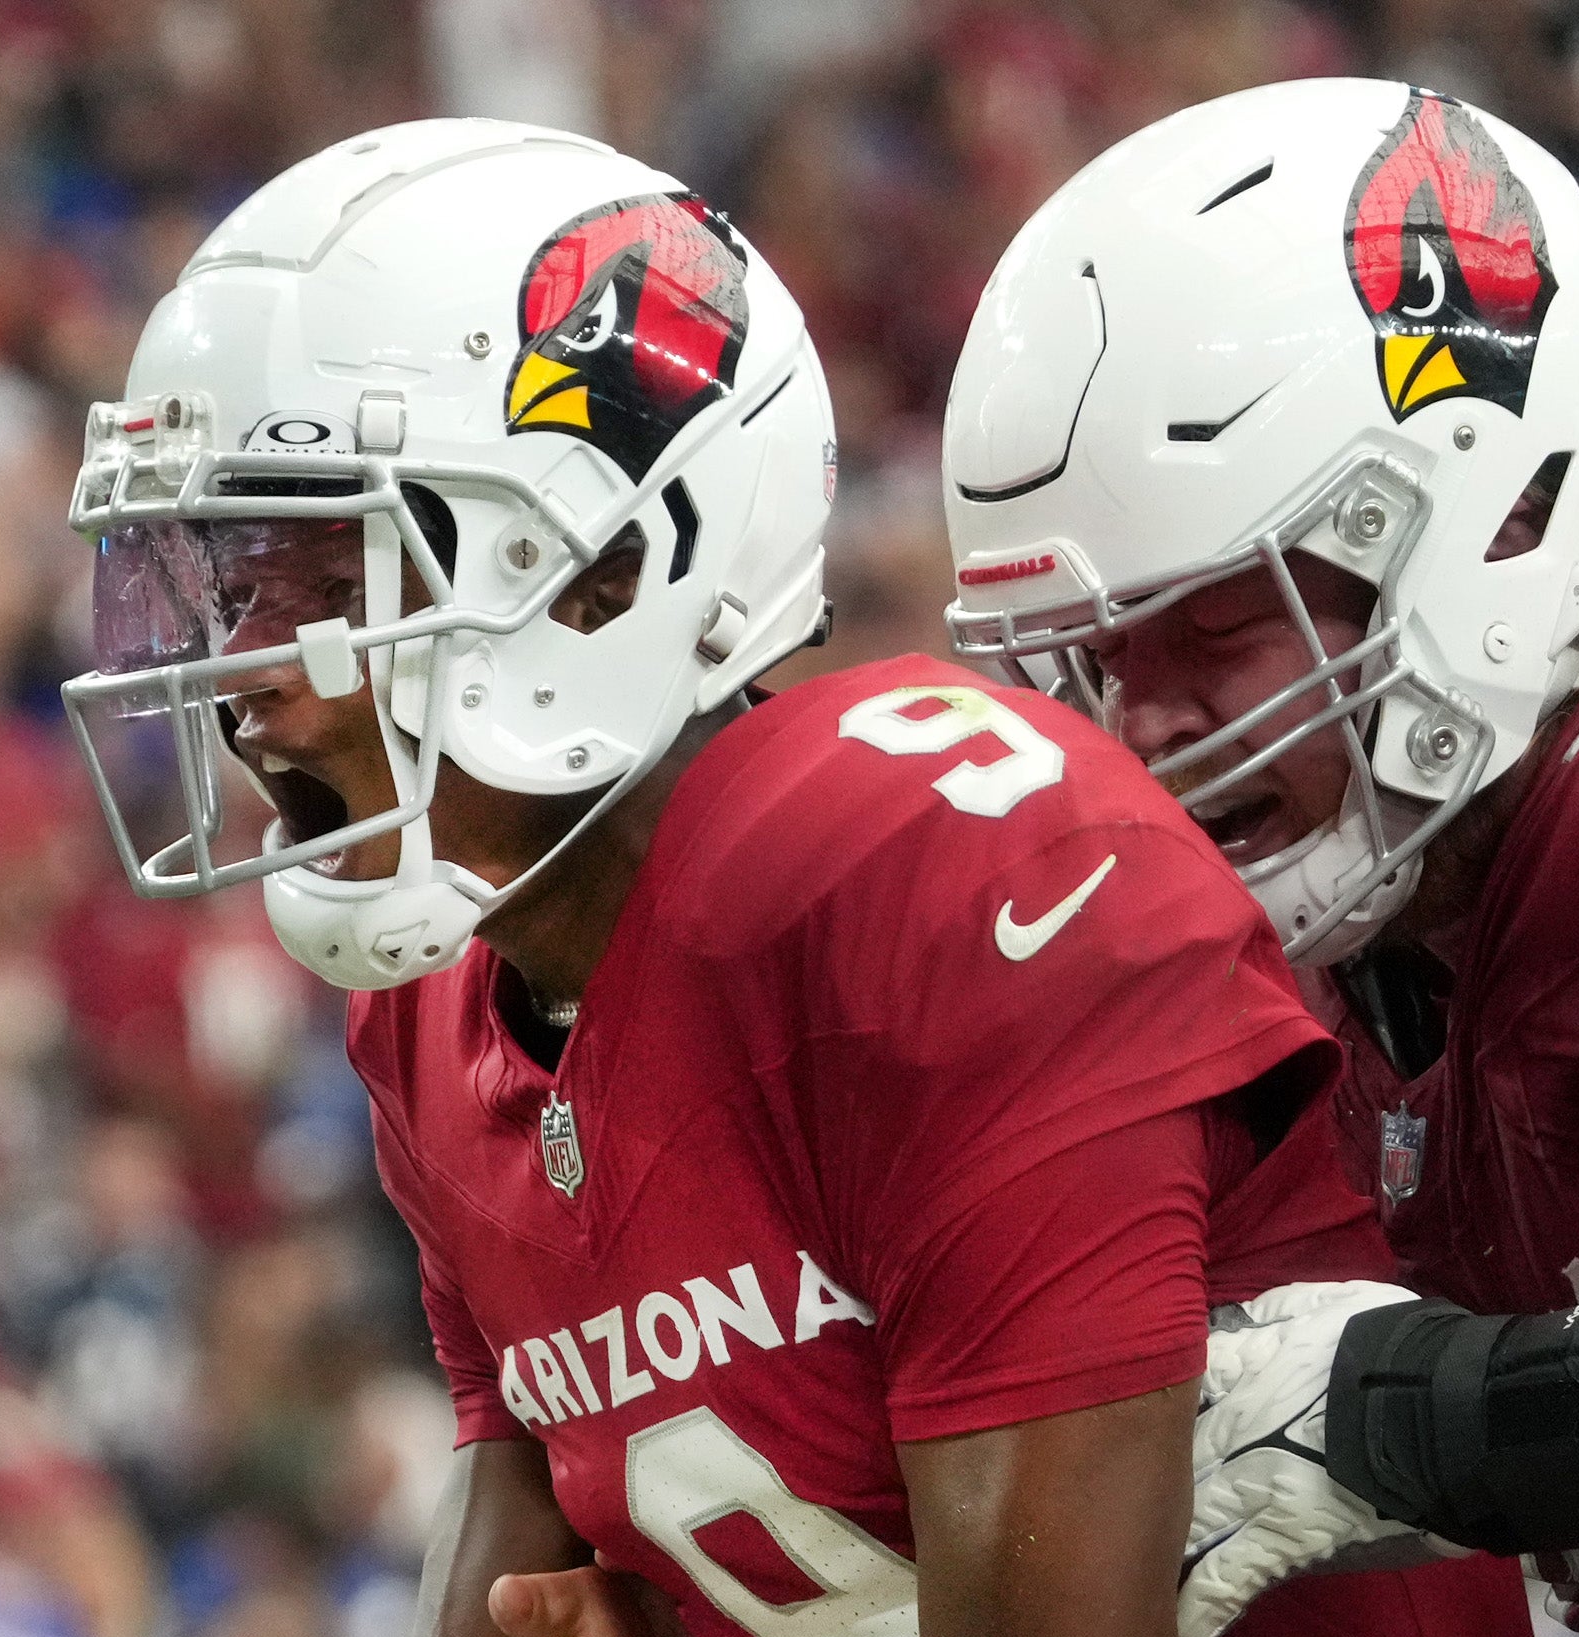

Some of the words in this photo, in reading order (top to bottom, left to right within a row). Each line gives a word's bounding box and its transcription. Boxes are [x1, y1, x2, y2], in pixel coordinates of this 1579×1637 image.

[837, 686, 1065, 818] 9
[547, 1140, 576, 1179] NFL
[501, 1249, 878, 1432] ARIZONA
